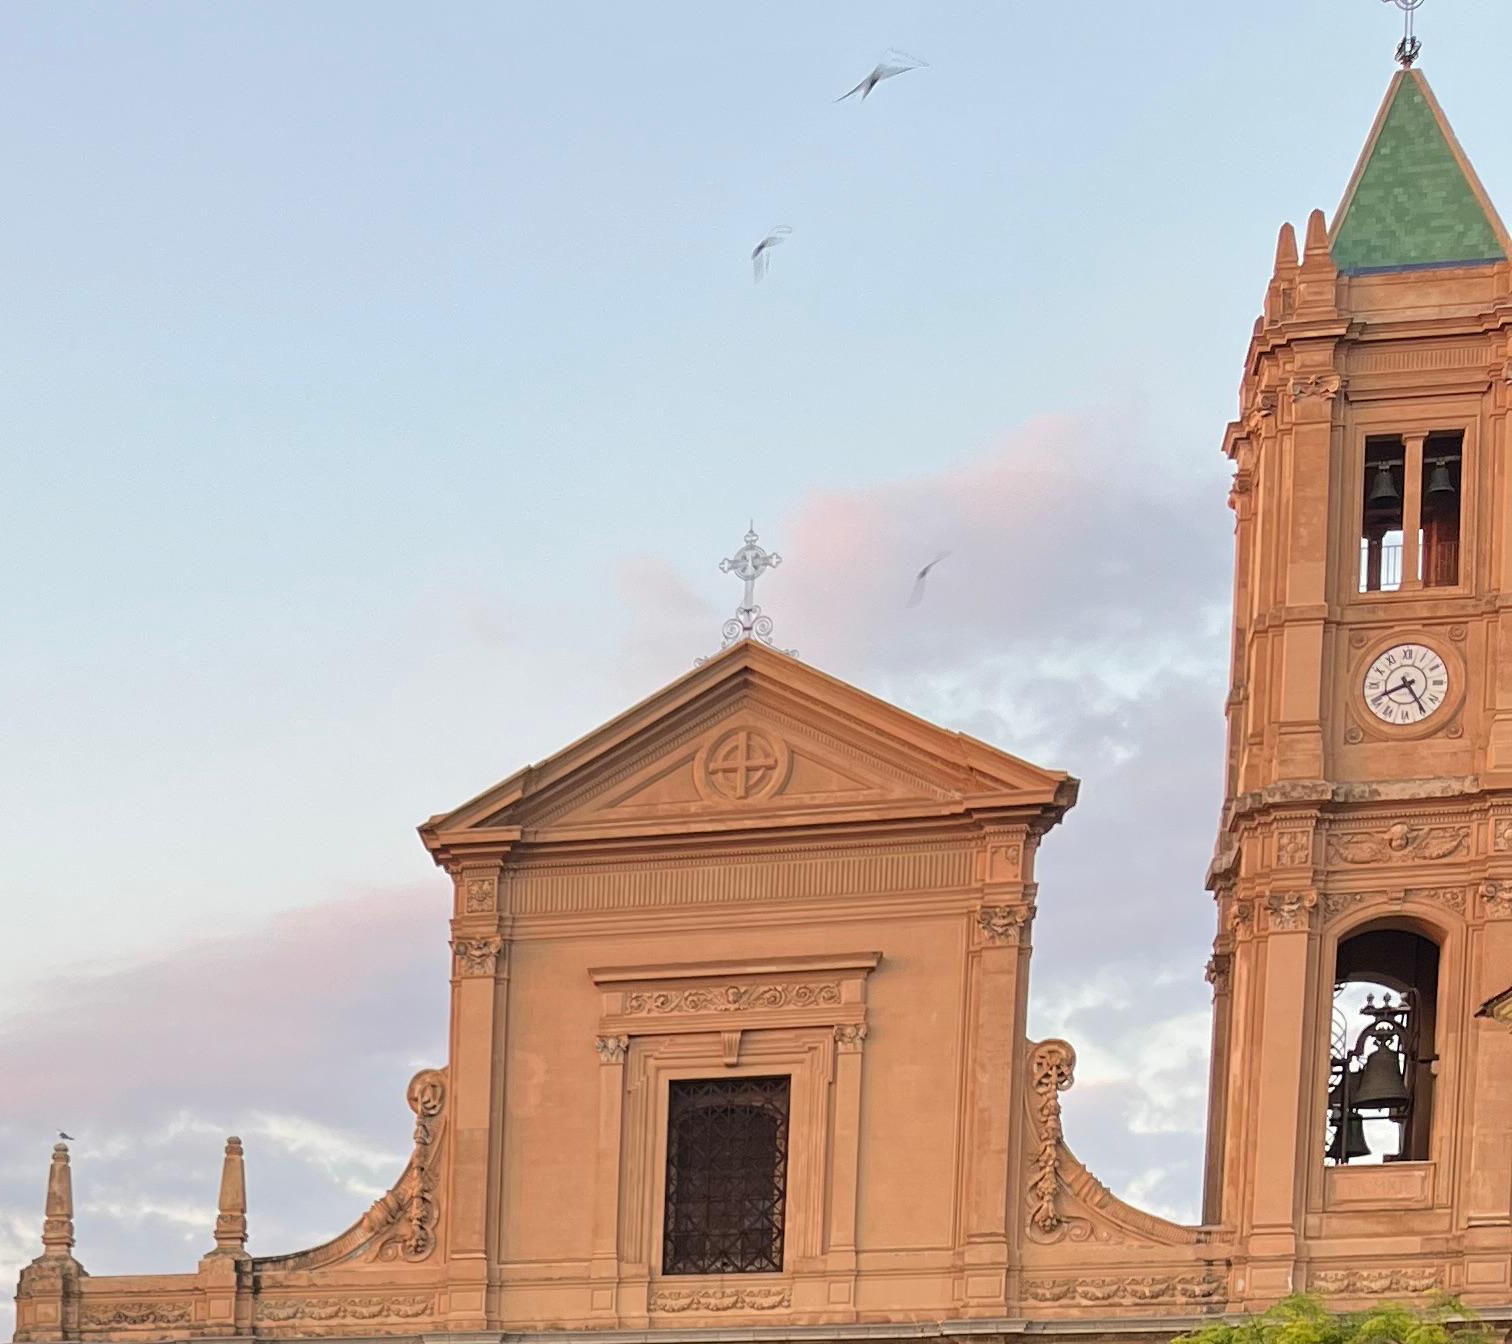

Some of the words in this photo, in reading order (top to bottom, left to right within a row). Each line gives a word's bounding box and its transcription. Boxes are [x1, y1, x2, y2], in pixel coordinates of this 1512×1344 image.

[1385, 654, 1397, 666] XI
[1402, 649, 1413, 660] XII
[1374, 667, 1385, 675] X
